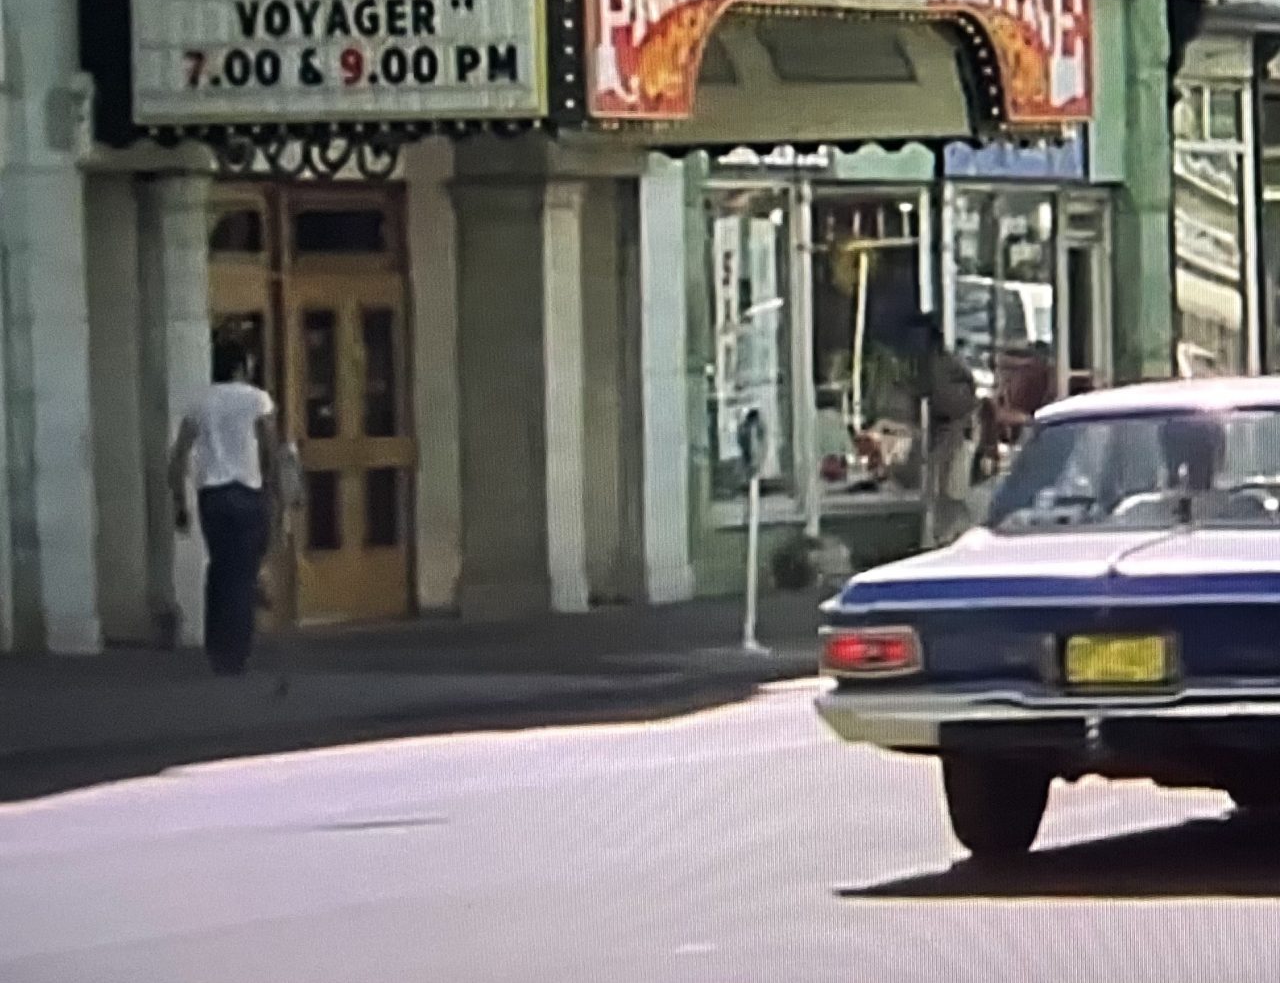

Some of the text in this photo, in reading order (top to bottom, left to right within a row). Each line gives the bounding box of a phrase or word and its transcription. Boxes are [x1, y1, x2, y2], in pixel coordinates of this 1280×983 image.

[184, 47, 281, 88] 7.00
[299, 48, 324, 86] &
[339, 46, 439, 85] 9.00
